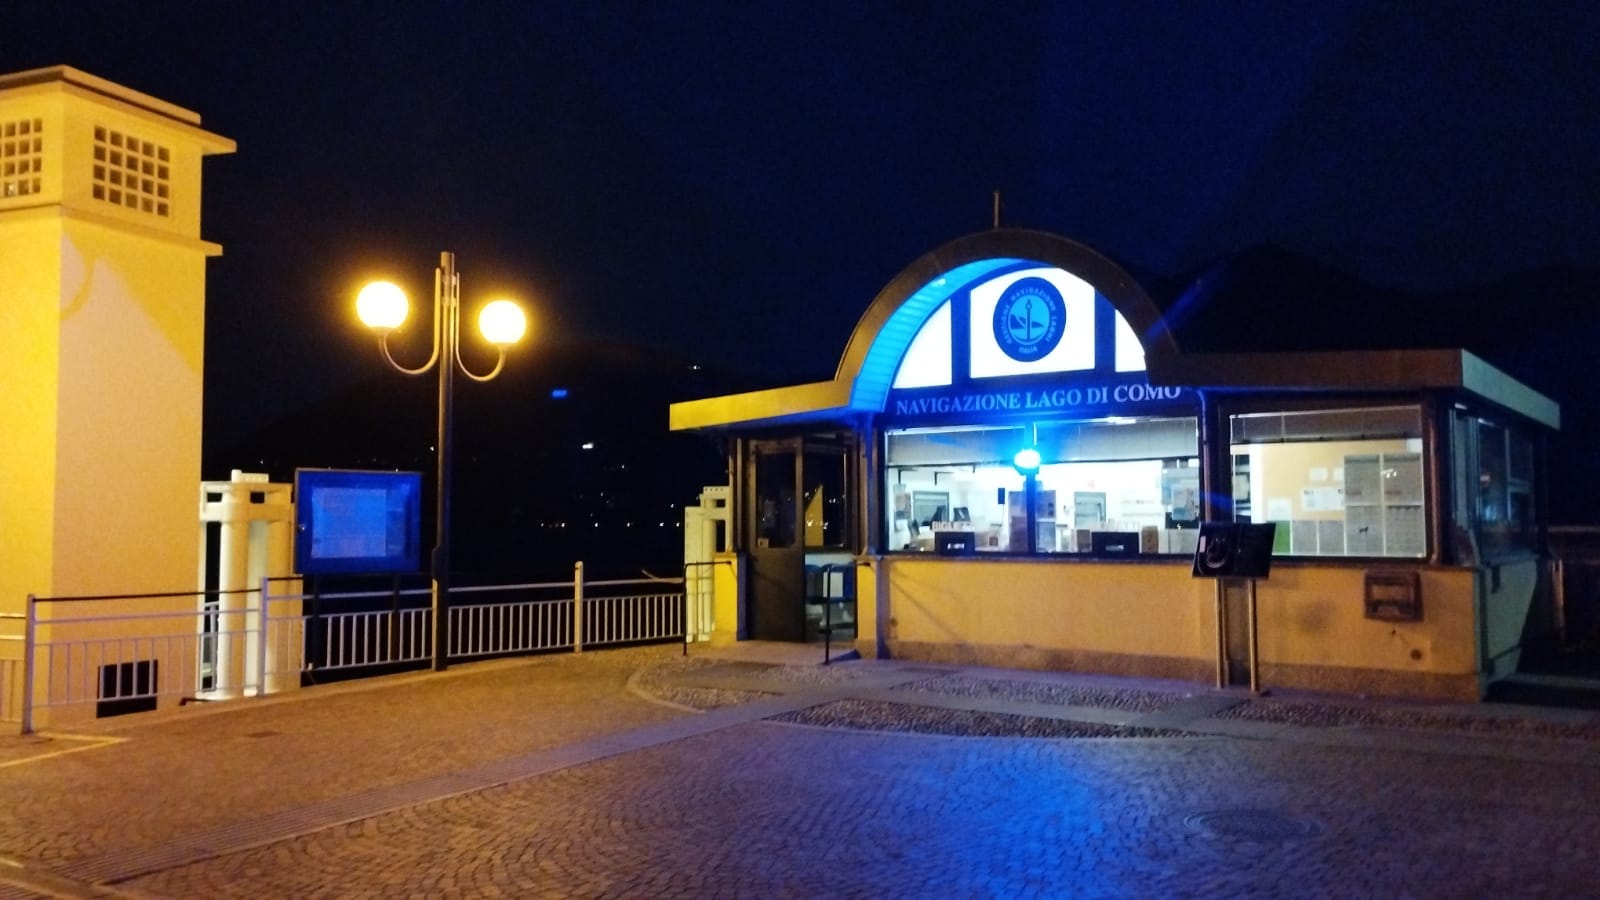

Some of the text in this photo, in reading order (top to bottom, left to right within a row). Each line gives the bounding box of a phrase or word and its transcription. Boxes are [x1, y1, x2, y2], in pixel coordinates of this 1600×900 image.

[896, 383, 1181, 416] NAVIGAZIONE LAGO DI COMO
